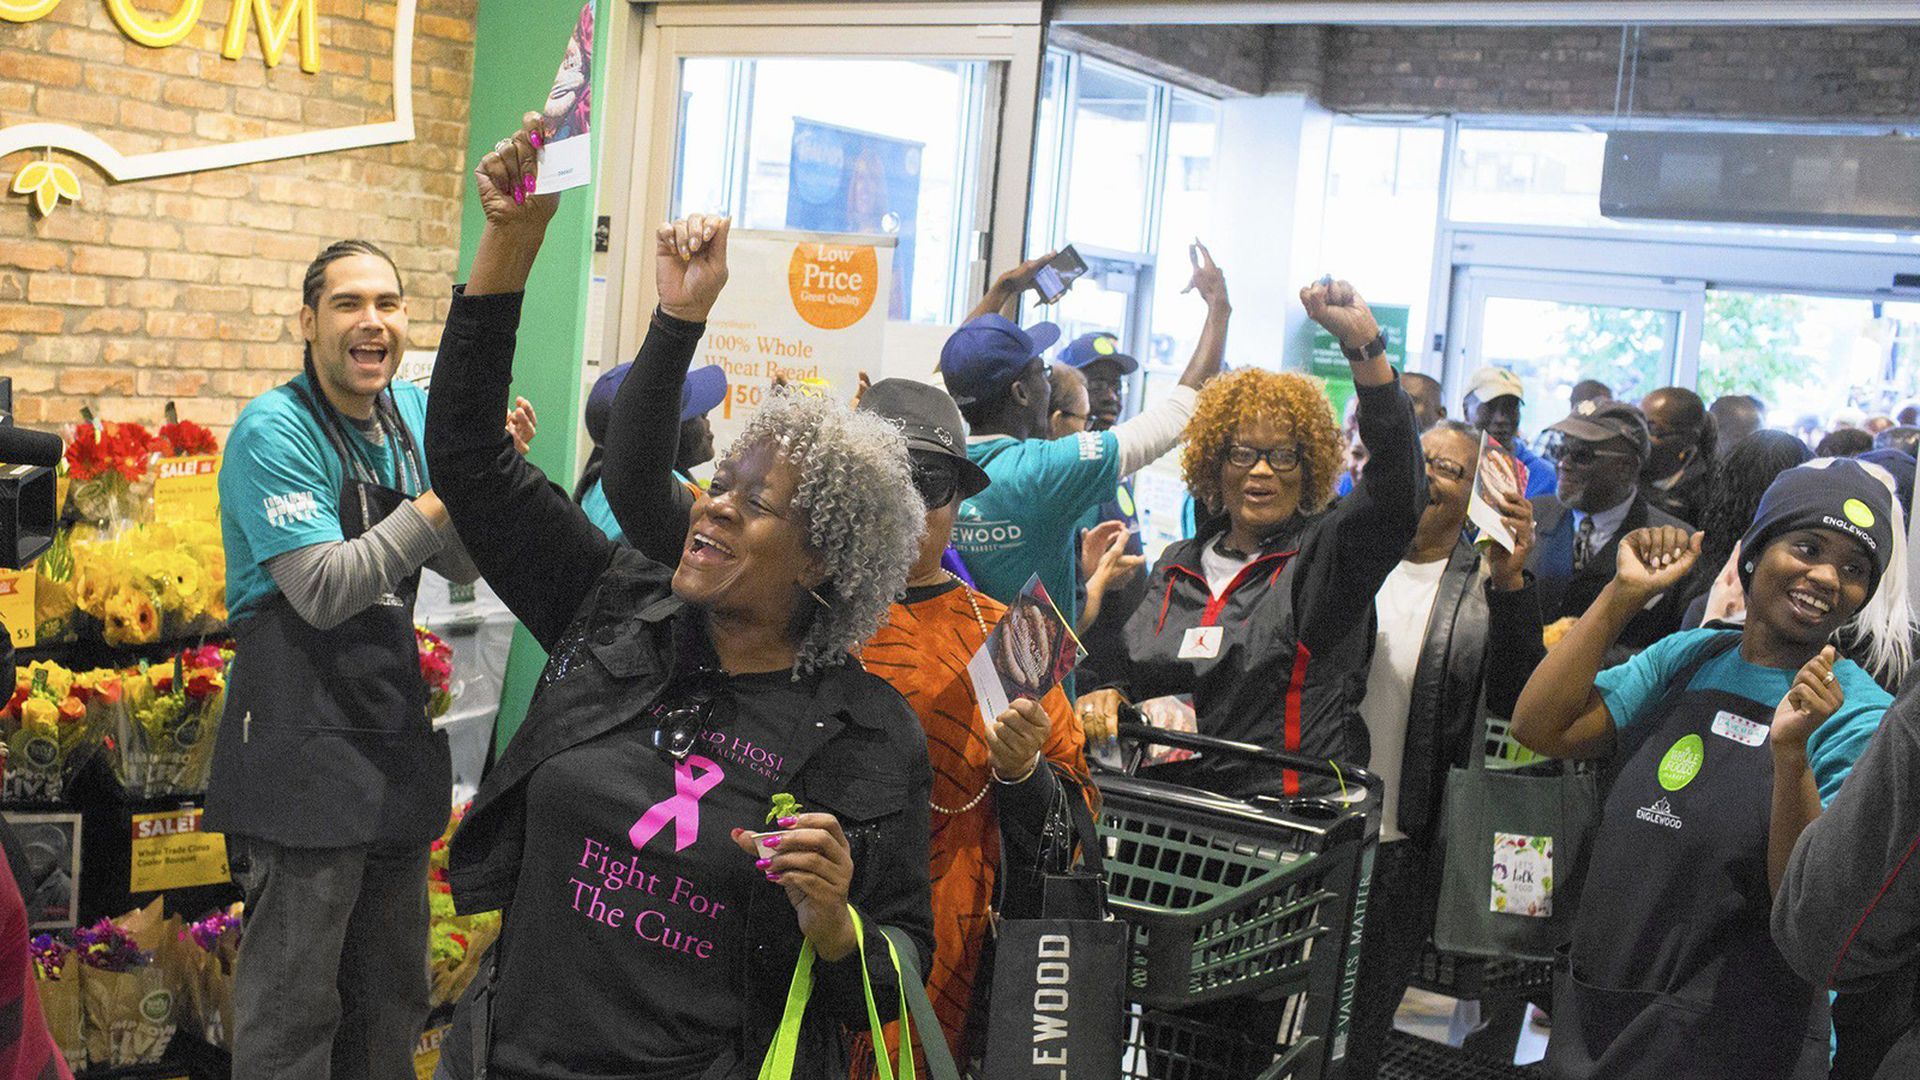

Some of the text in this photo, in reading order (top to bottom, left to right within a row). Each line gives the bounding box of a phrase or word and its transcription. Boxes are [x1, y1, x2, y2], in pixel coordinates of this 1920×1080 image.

[816, 244, 855, 264] Low
[802, 264, 863, 292] Price
[800, 290, 859, 307] Great Quality
[707, 334, 813, 359] 100% Whole
[159, 460, 198, 480] SALE!
[1822, 515, 1877, 550] ENGLEWOOD
[138, 815, 195, 838] SALE!
[1636, 808, 1682, 830] ENGLEWOOD
[578, 837, 725, 920] Fight For
[568, 877, 713, 959] The Cure
[1337, 955, 1360, 1028] VALUES
[1350, 873, 1373, 946] MATTER
